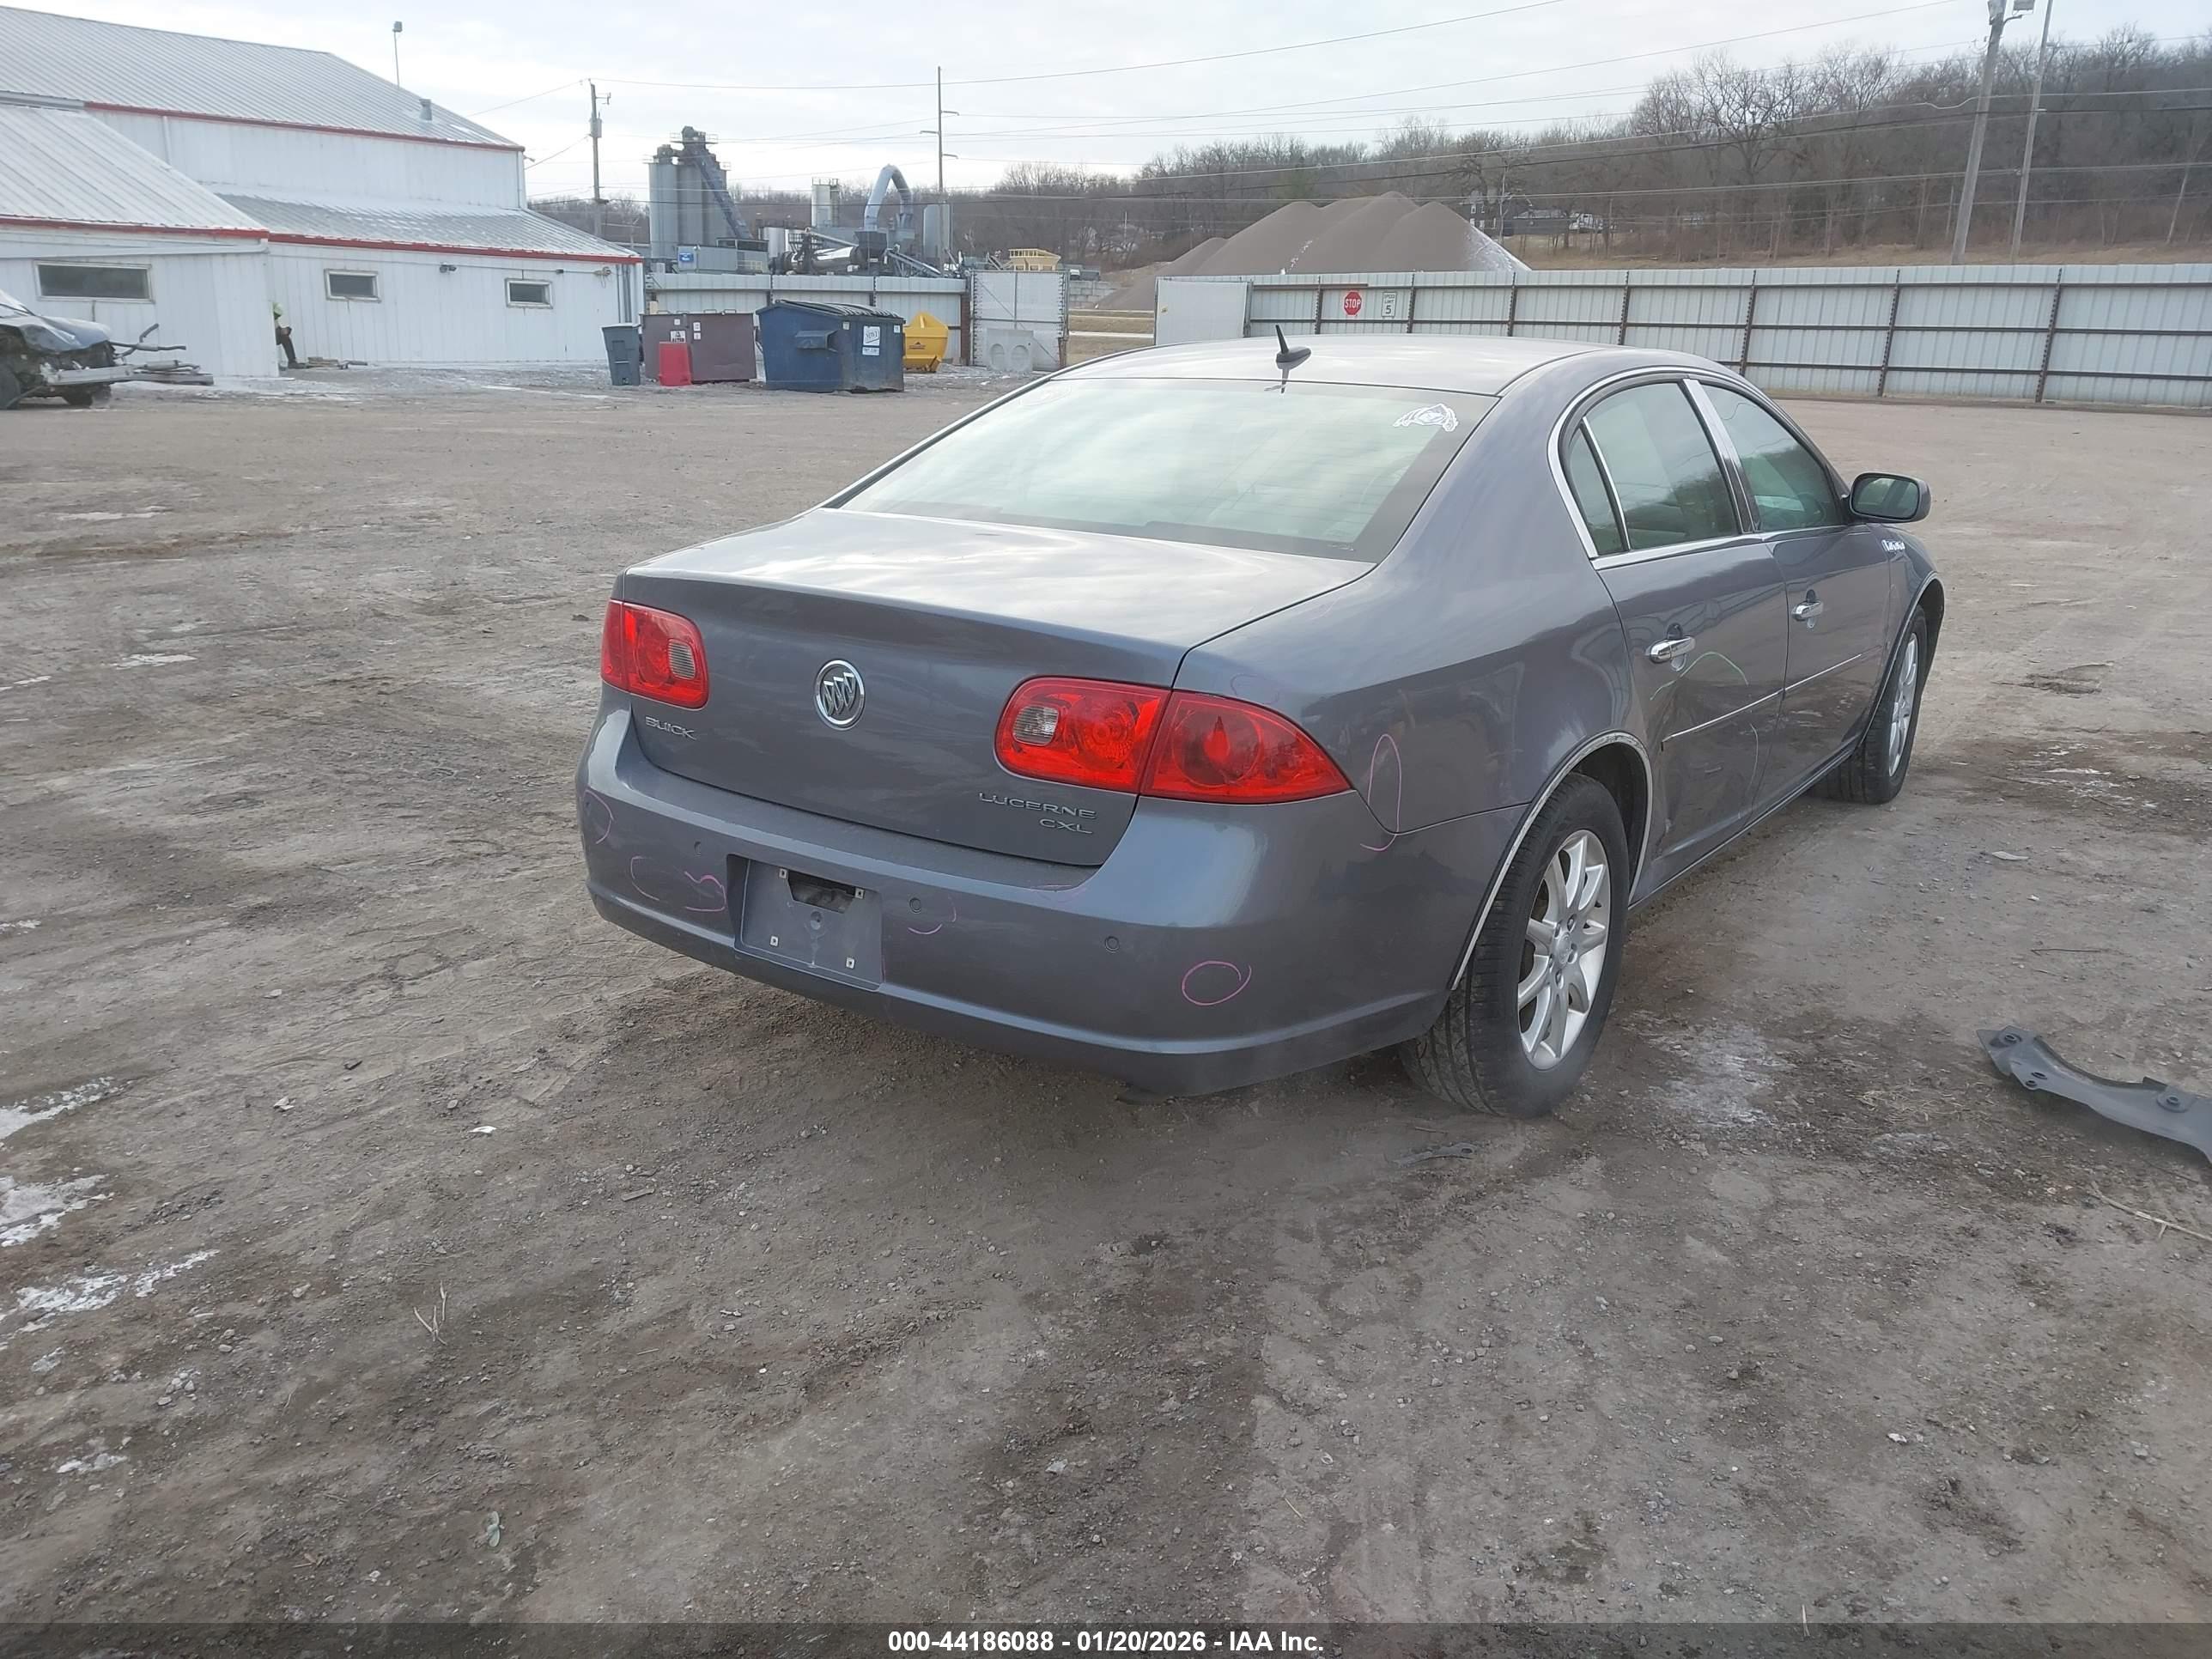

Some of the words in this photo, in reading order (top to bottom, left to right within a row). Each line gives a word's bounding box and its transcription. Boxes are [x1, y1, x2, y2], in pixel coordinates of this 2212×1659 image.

[1345, 298, 1361, 308] STOP
[1385, 305, 1392, 314] 5
[645, 715, 697, 740] BUICK
[979, 792, 1097, 819] LUCERNE
[1039, 818, 1093, 834] CXL
